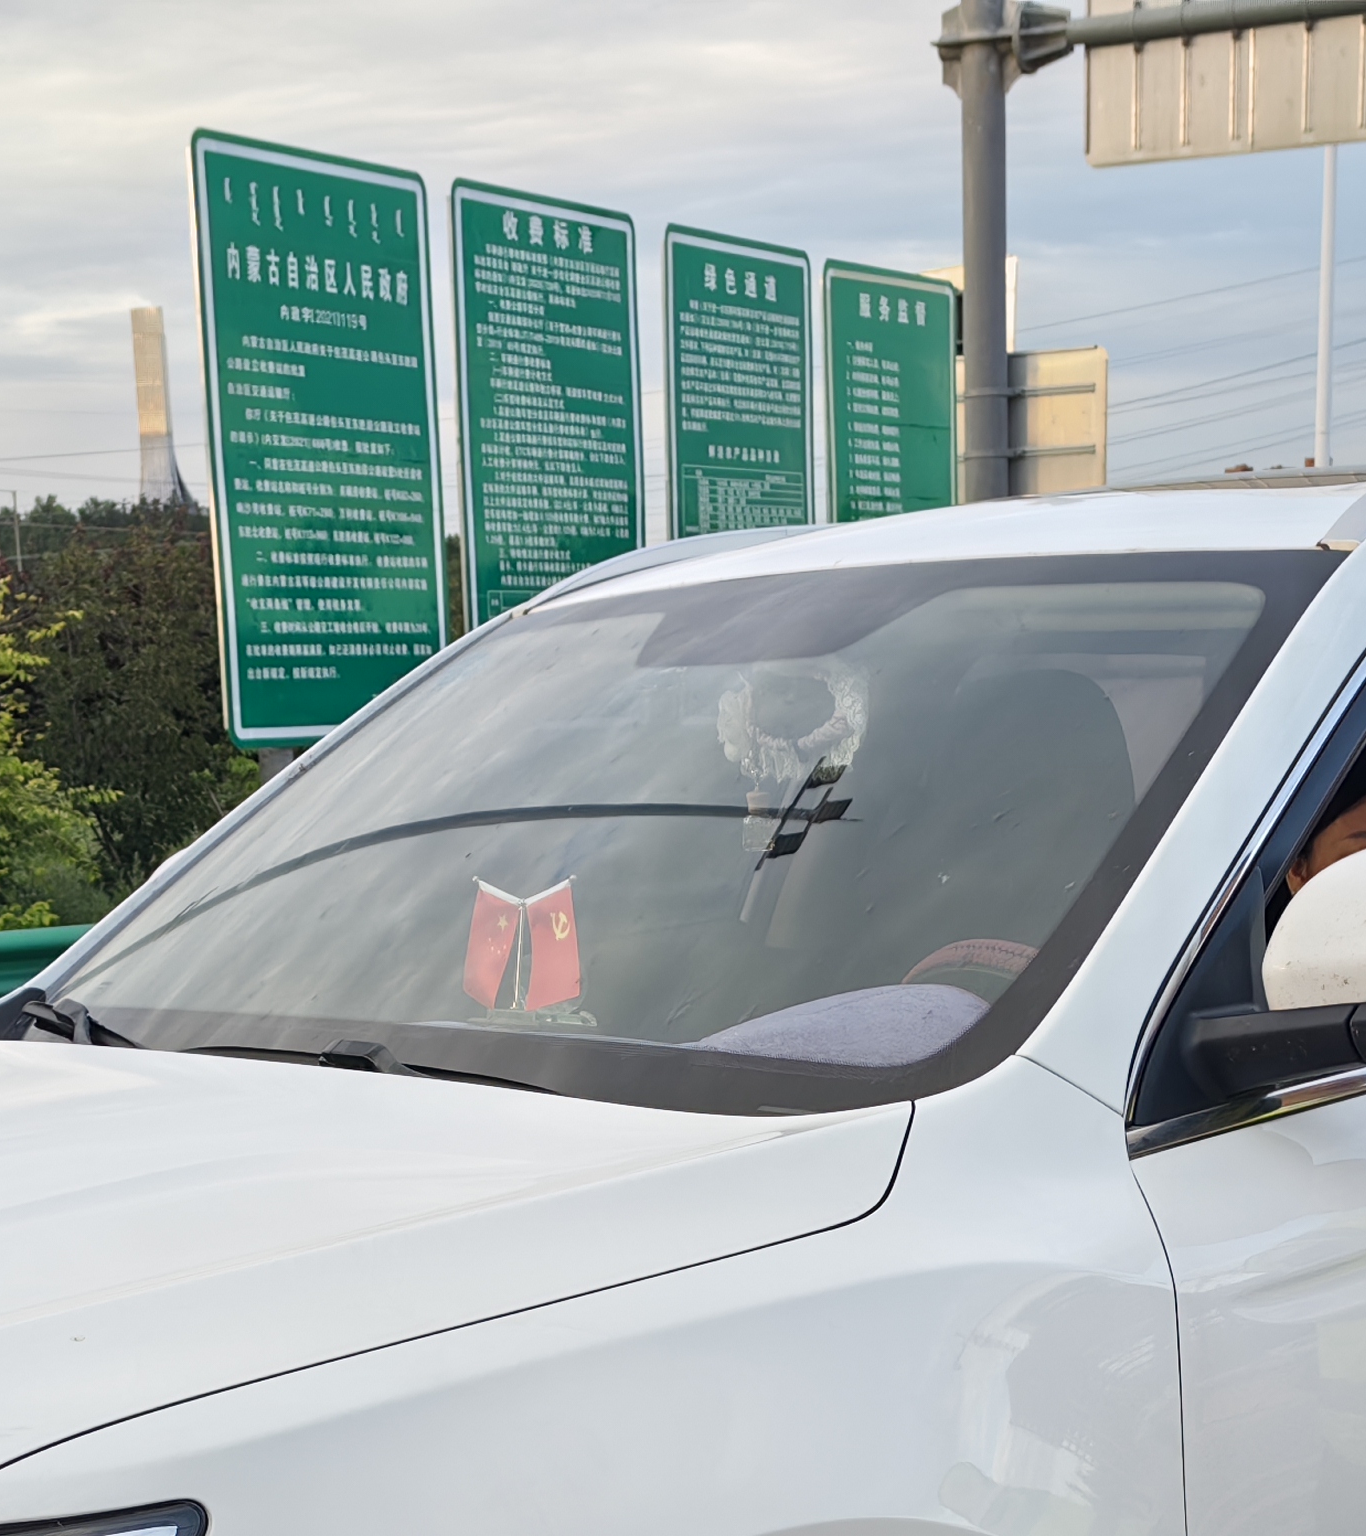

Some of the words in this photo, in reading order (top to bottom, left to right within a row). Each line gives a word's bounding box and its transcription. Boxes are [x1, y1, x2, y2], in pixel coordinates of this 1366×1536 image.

[502, 210, 593, 255] 收费标准
[226, 241, 408, 306] 内蒙古自治区人民政府
[703, 263, 777, 302] 绿色通道
[859, 292, 926, 327] 服务监督
